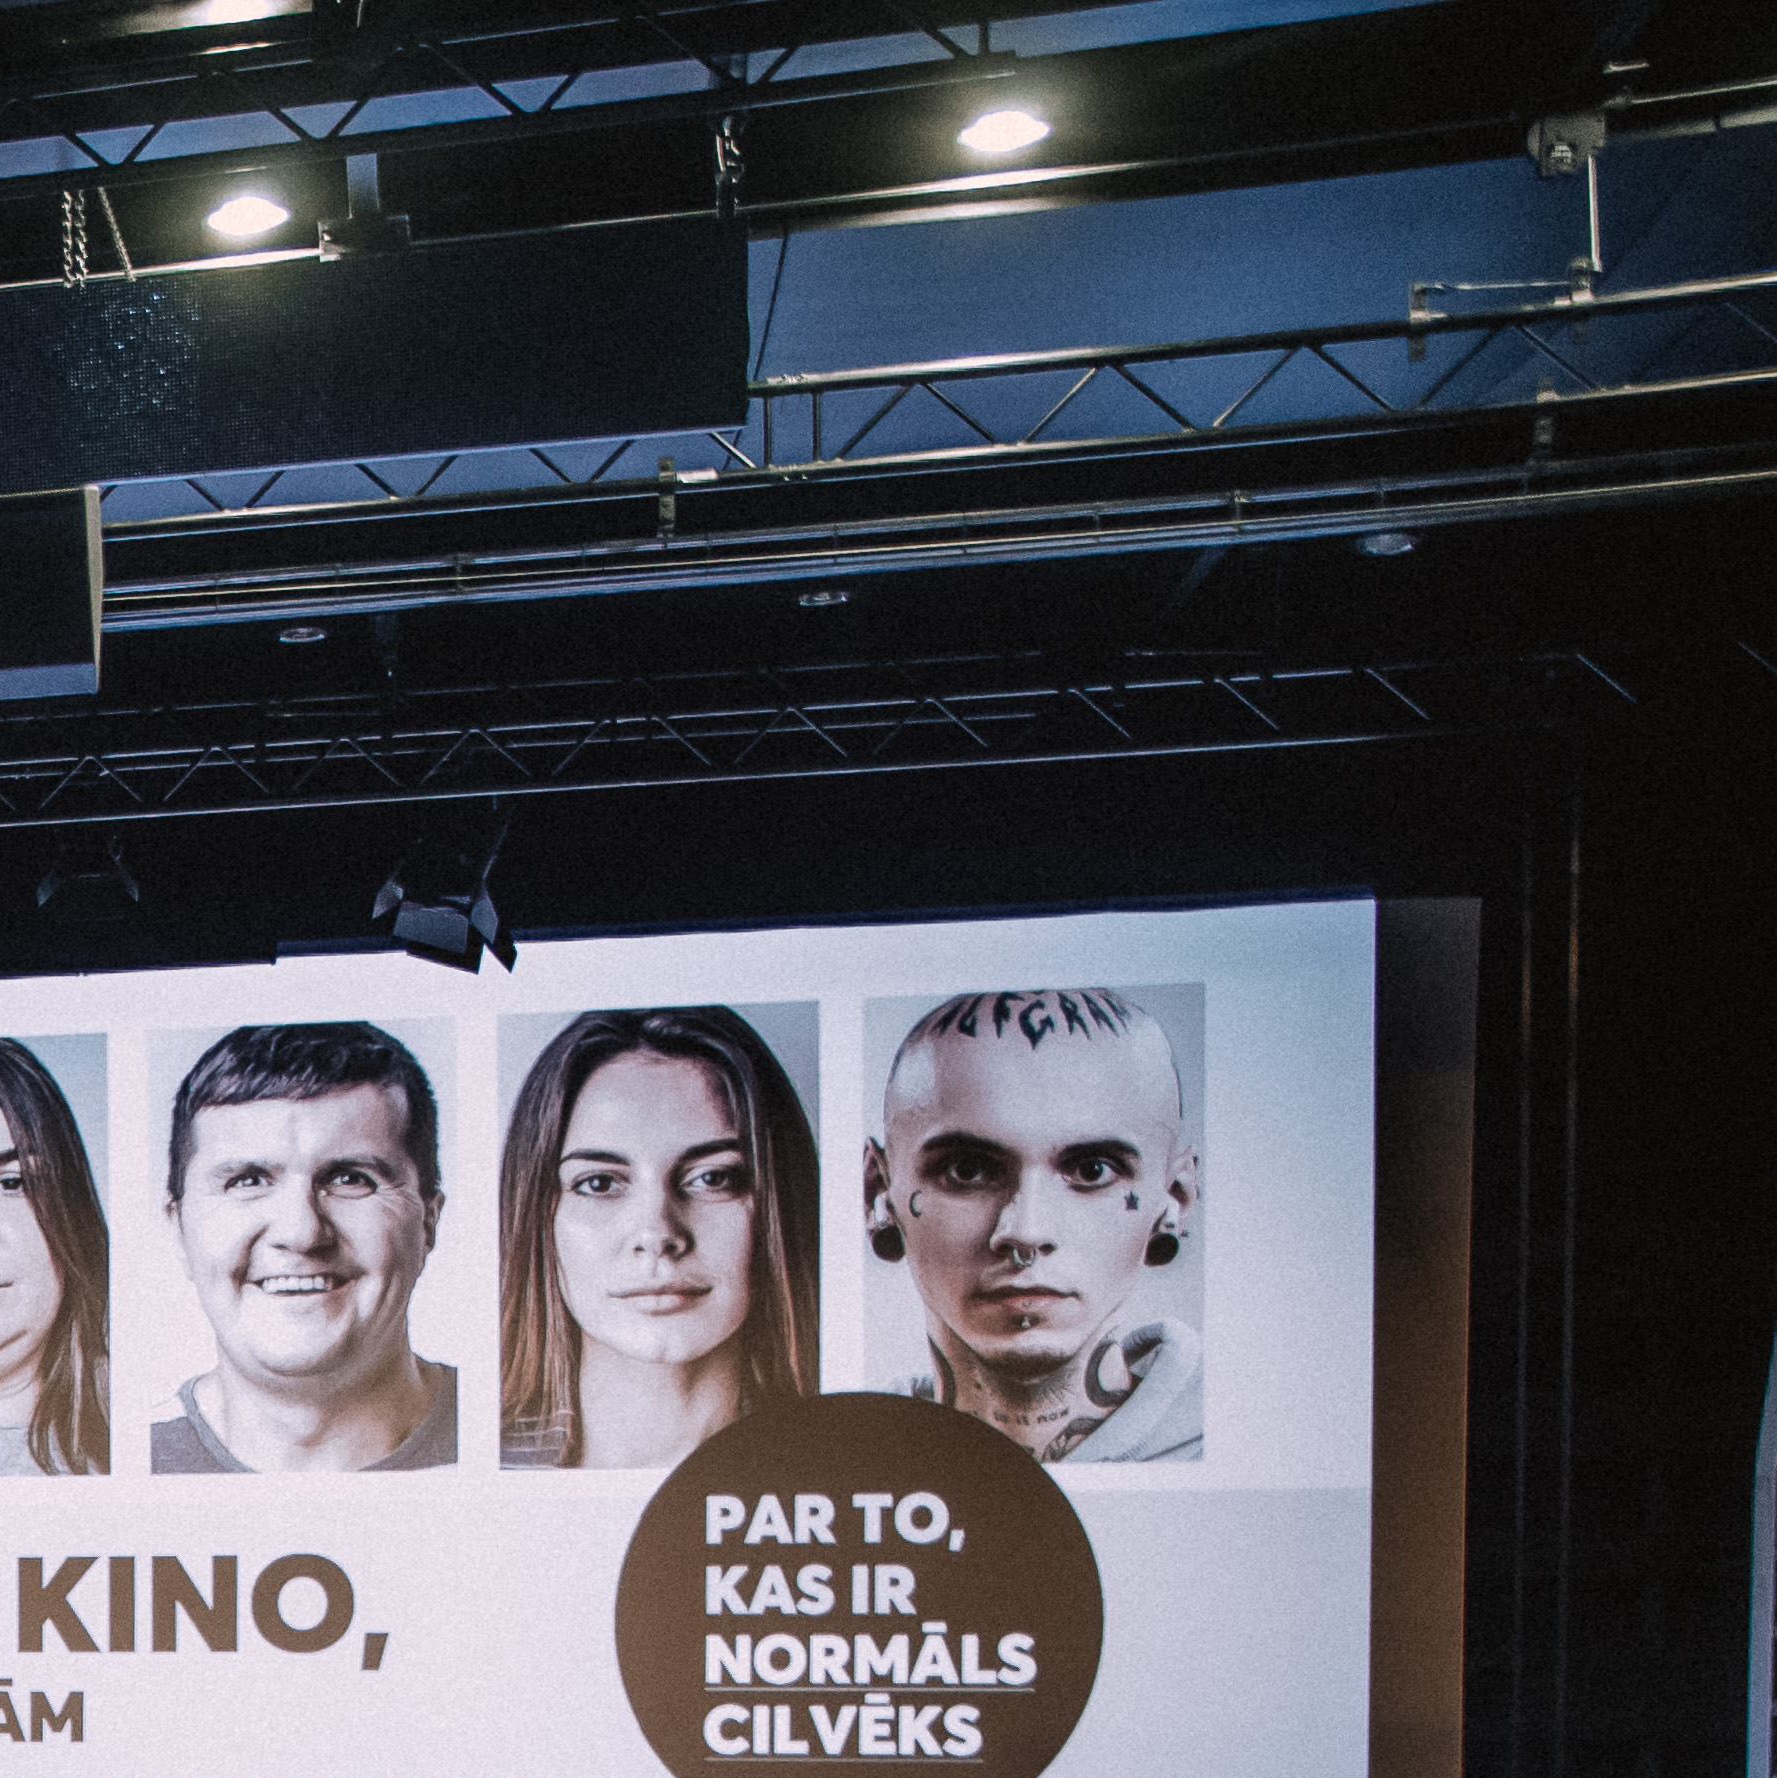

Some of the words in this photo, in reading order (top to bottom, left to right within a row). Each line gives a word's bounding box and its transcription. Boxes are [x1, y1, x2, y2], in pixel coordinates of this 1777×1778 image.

[705, 1494, 836, 1545] PAR
[852, 1491, 965, 1552] TO,
[16, 1552, 390, 1673] KINO,
[705, 1563, 835, 1615] KAS
[852, 1564, 916, 1615] IR
[704, 1621, 1037, 1686] NORMĀLS
[703, 1693, 983, 1757] CILVĒKS
